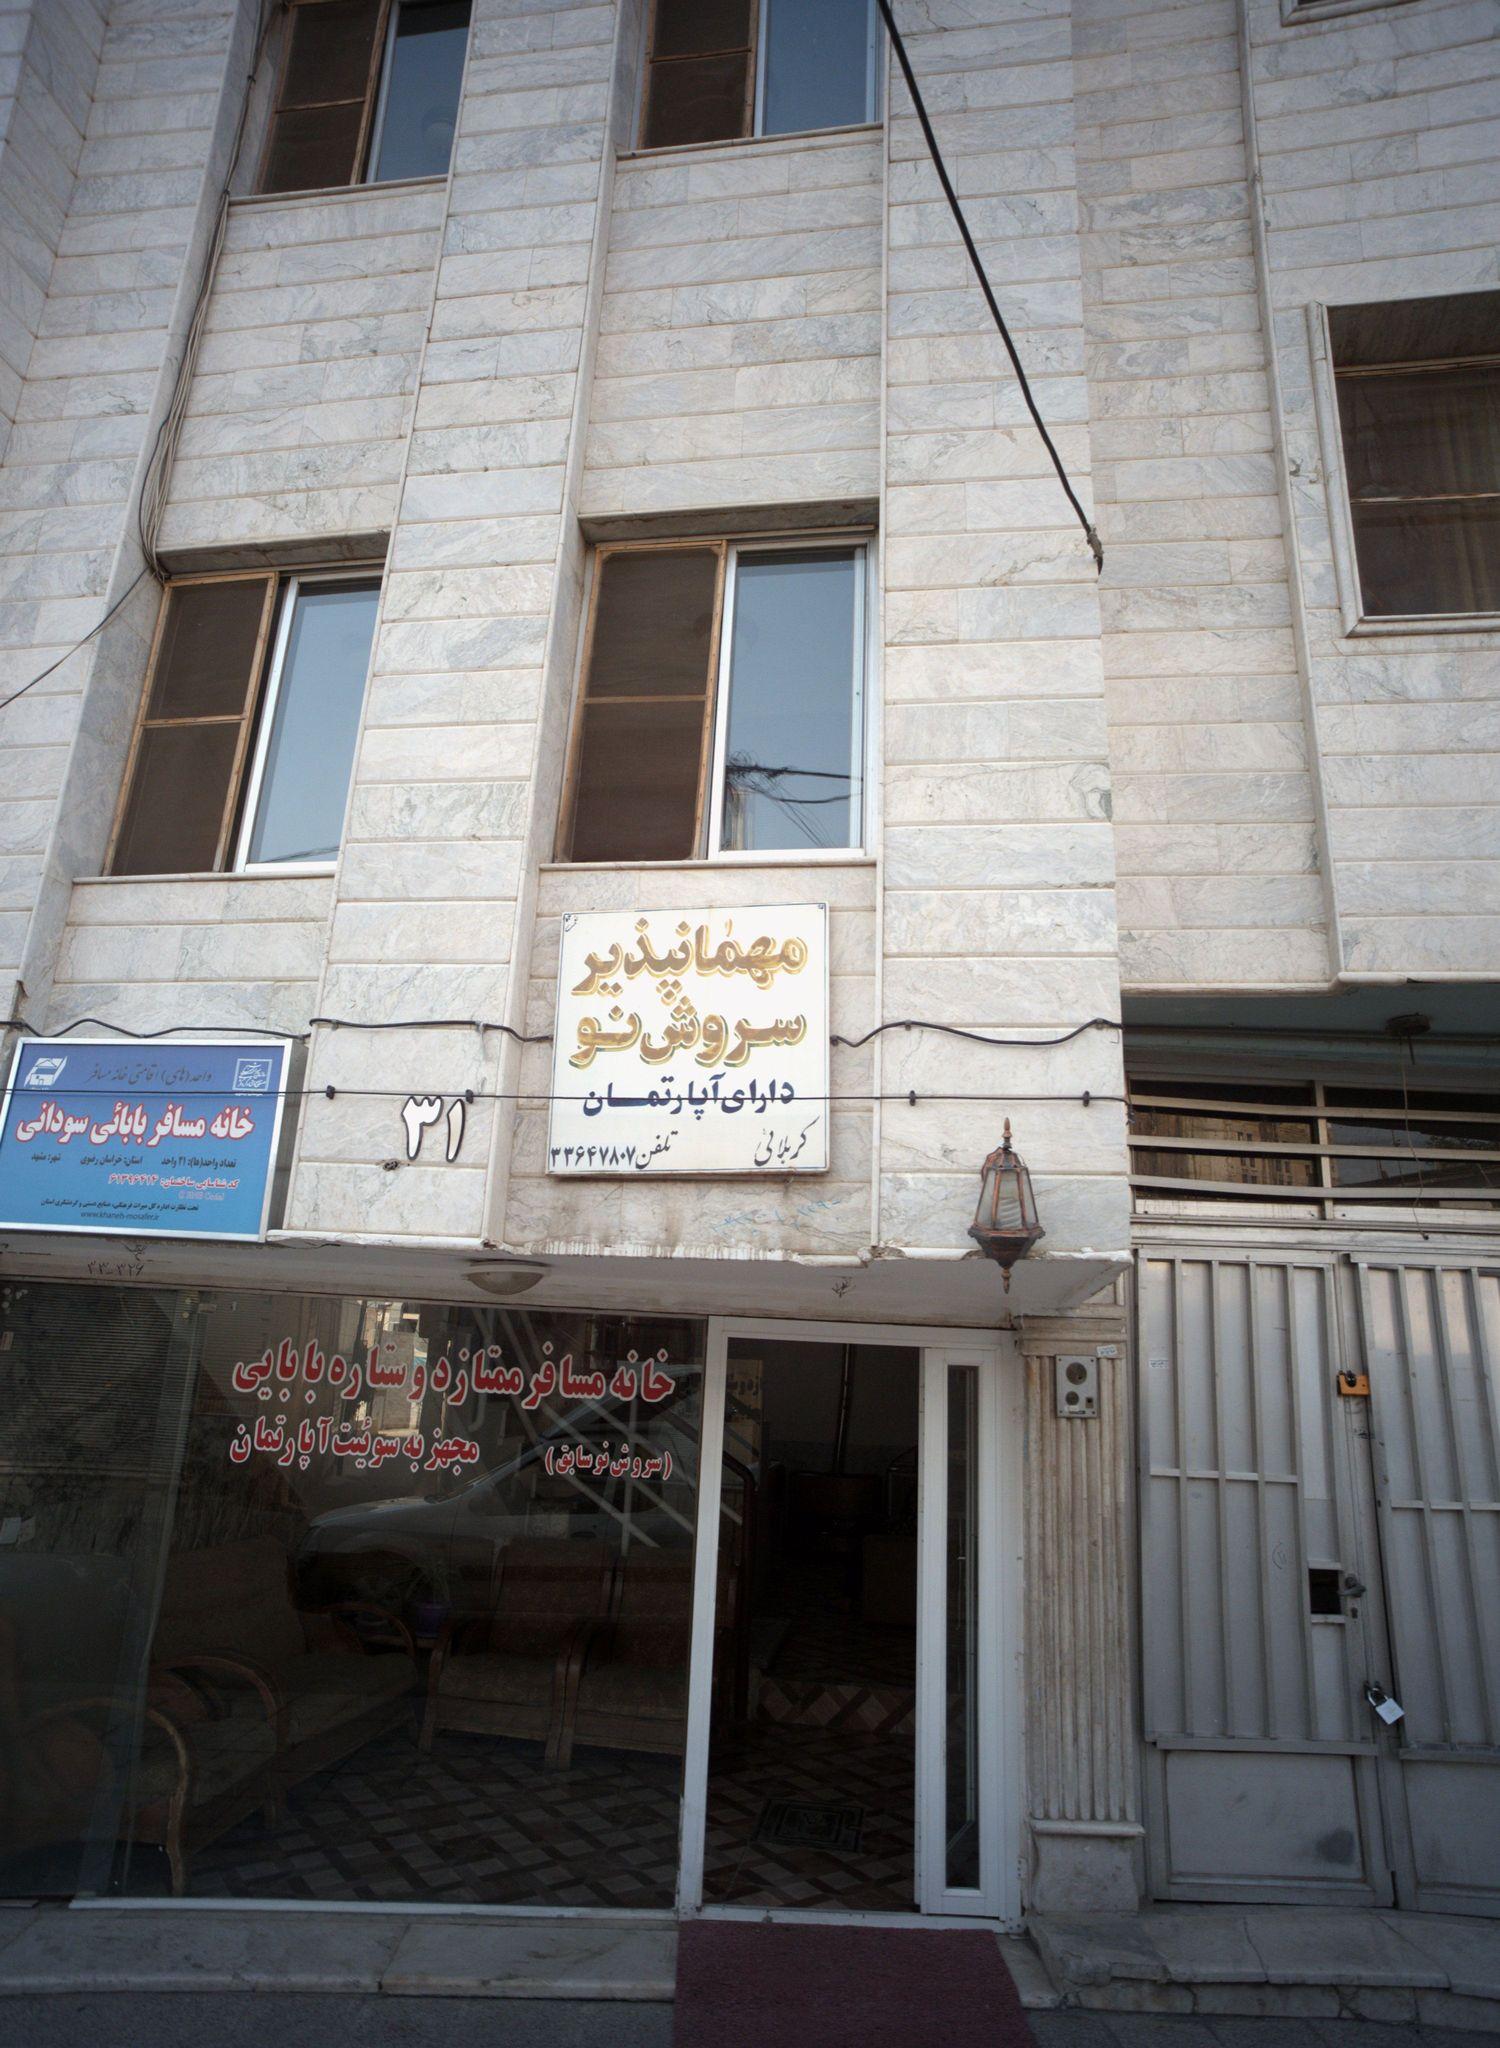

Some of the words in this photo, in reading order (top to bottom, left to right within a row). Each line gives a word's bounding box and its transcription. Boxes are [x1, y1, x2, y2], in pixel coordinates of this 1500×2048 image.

[568, 1005, 642, 1070] نو
[640, 995, 807, 1068] سروش
[583, 1072, 726, 1120] آپارتمان
[721, 1078, 795, 1114] دارای
[16, 1101, 90, 1144] سودانی
[89, 1100, 149, 1145] بابائی
[147, 1103, 206, 1147] مسافر
[209, 1105, 254, 1139] خانه
[550, 1145, 637, 1168] ۳۳۶۴۷۸۰۷
[635, 1130, 679, 1169] تلفن
[232, 1337, 327, 1404] بابایی
[329, 1343, 408, 1400] ستاره
[407, 1354, 451, 1401] دو
[447, 1344, 523, 1405] ممتاز
[522, 1341, 606, 1409] مسافر
[609, 1348, 676, 1401] خانه
[229, 1415, 330, 1470] آپارتمان
[401, 1433, 427, 1473] به
[424, 1433, 481, 1478] مجهز
[592, 1441, 611, 1476] نو
